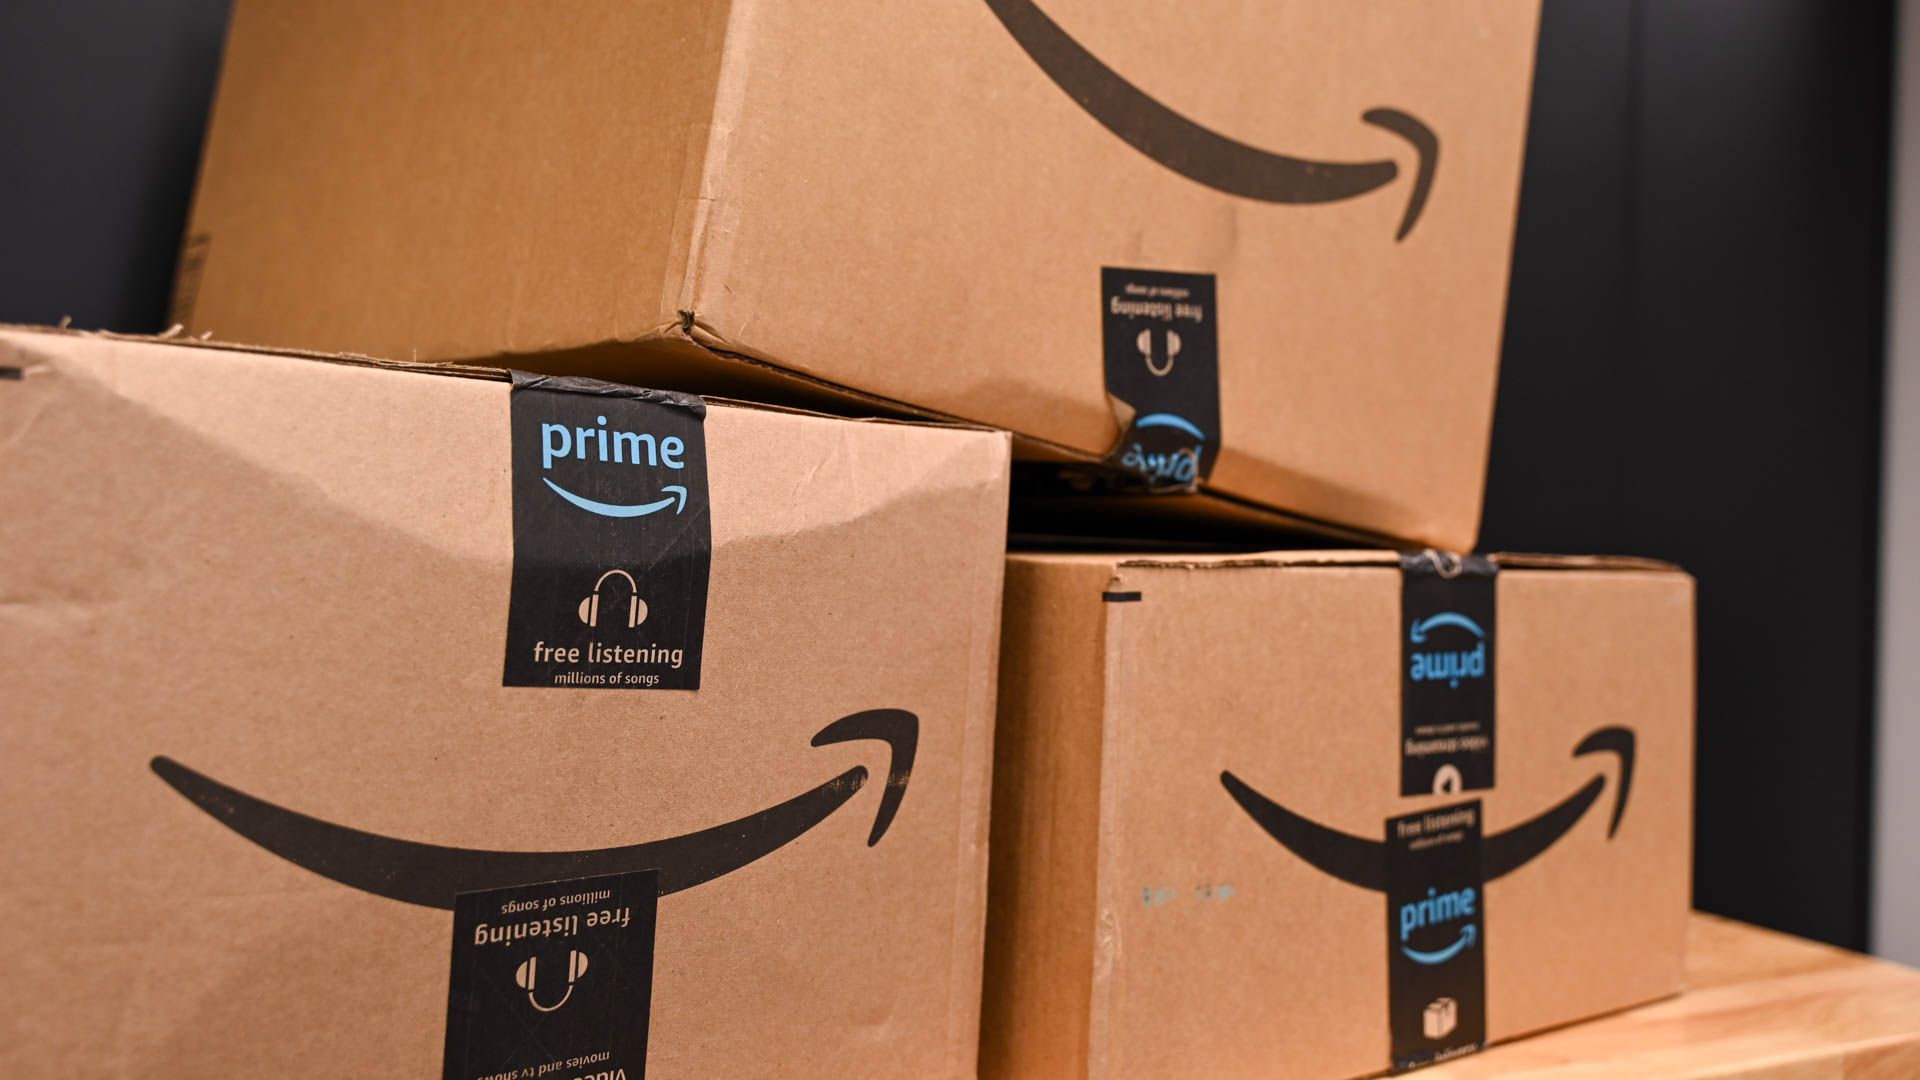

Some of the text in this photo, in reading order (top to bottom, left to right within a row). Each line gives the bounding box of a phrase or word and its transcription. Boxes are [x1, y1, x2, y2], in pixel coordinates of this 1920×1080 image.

[541, 415, 685, 469] prime
[533, 640, 684, 669] free listening
[1410, 640, 1486, 689] prime
[554, 671, 660, 687] millions of songs
[501, 889, 611, 915] millions of songs
[1401, 886, 1477, 942] prime
[473, 907, 631, 947] free listening
[521, 1068, 535, 1078] tv
[538, 1060, 563, 1078] and
[566, 1050, 611, 1069] movies
